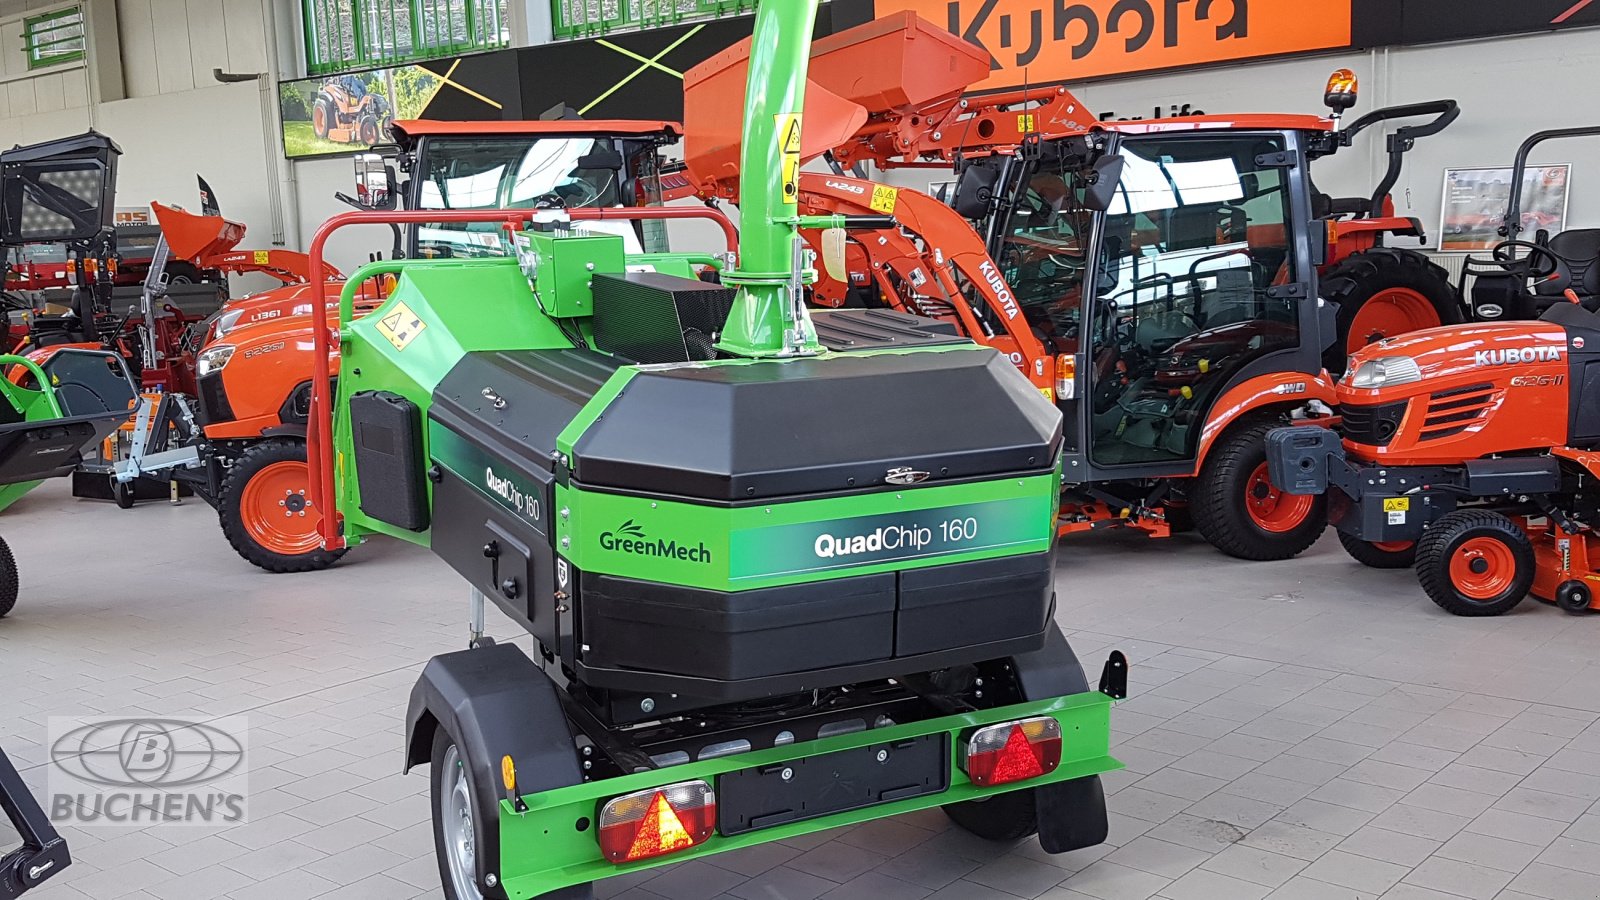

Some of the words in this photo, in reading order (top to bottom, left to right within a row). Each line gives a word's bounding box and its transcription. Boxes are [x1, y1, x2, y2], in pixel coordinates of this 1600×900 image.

[946, 0, 1249, 71] Kubota
[825, 180, 865, 194] LA243
[978, 260, 1019, 321] KUBOTA
[251, 309, 281, 322] L1361
[1474, 345, 1562, 366] KUBOTA
[486, 466, 524, 513] QuadChip
[525, 493, 540, 521] 160
[599, 531, 711, 564] GreenMech
[814, 523, 932, 558] QuadChip
[939, 517, 978, 542] 160
